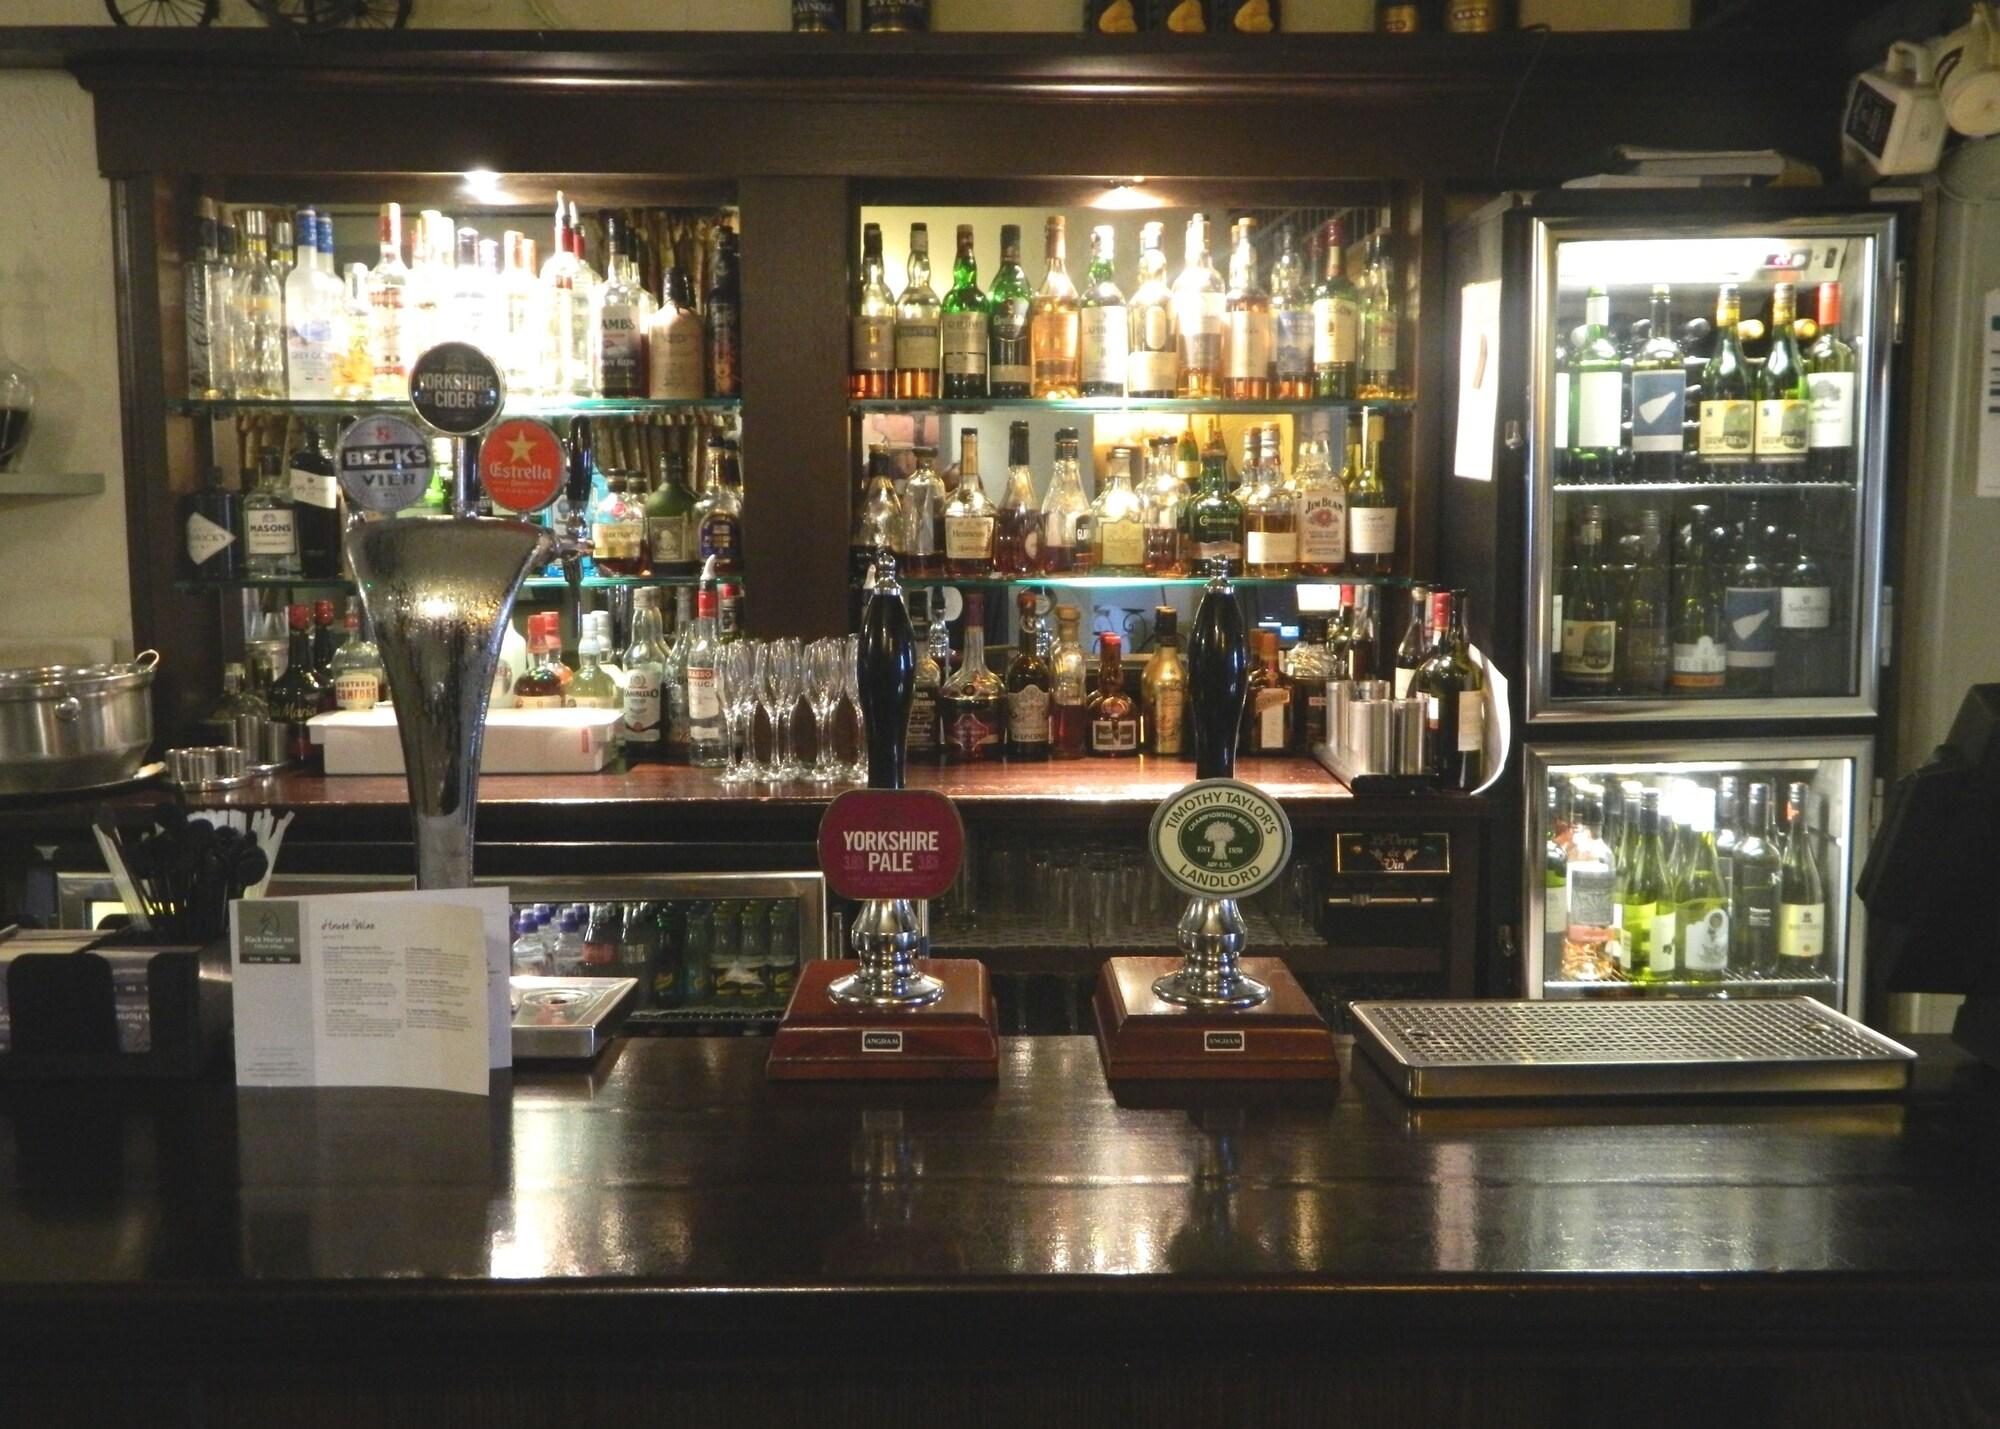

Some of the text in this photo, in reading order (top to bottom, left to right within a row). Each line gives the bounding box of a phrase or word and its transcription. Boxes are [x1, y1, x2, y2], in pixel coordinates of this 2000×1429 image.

[418, 373, 493, 391] YORKSHIRE
[434, 391, 477, 409] CIDER
[344, 446, 428, 466] BECK'S
[360, 473, 416, 487] VIER
[489, 463, 552, 481] Estrella
[1305, 500, 1321, 514] JIM
[249, 524, 291, 533] MASONS
[1165, 791, 1278, 835] TIMOTHY TAYLOR'S
[1188, 812, 1237, 832] CHAMPIONSHIP
[843, 830, 939, 852] YORKSHIRE
[868, 852, 914, 873] PALE
[1381, 858, 1405, 871] Vin
[1178, 863, 1261, 888] LANDLORD
[321, 918, 349, 931] House
